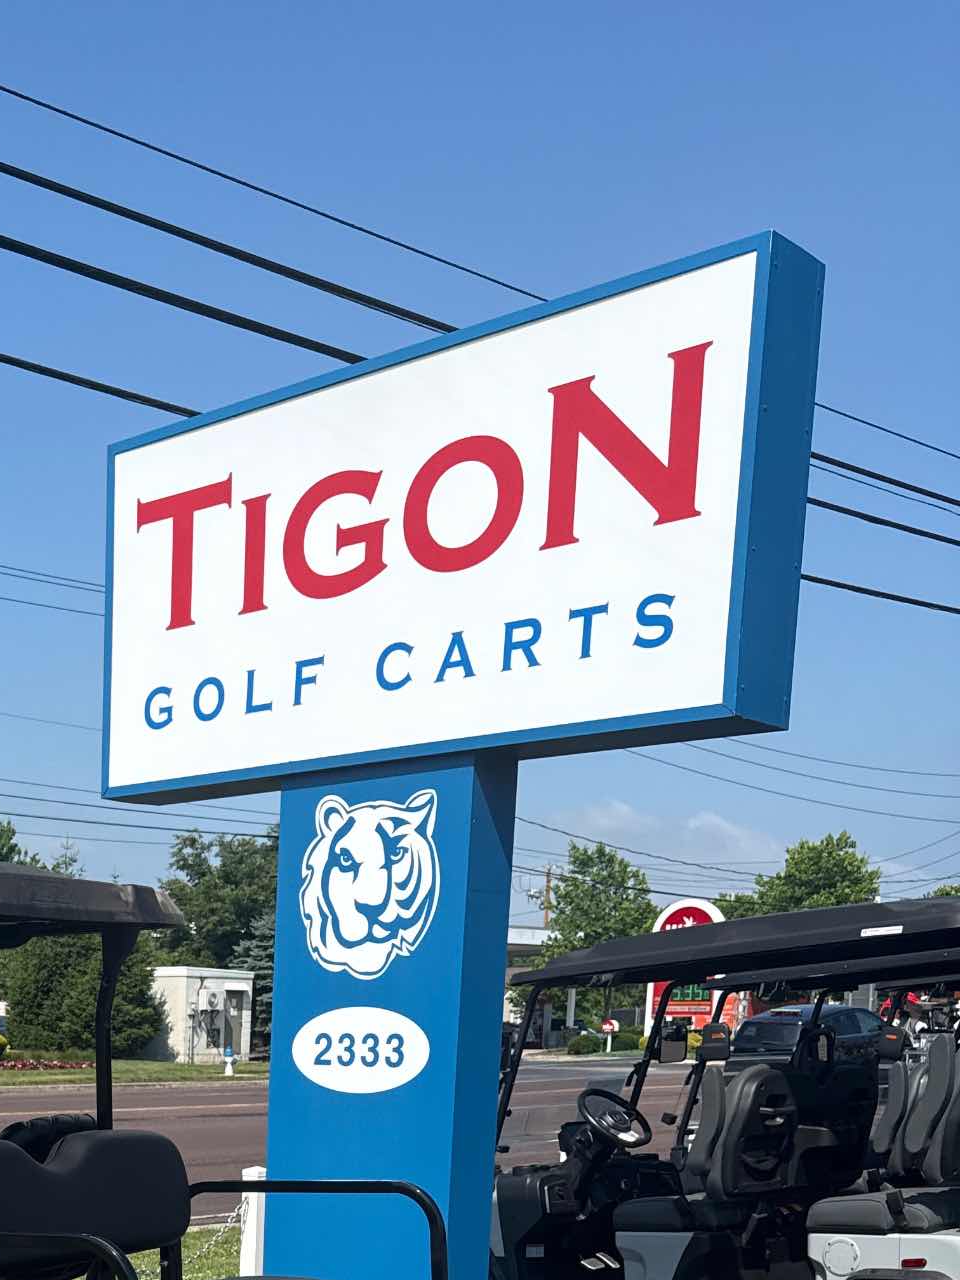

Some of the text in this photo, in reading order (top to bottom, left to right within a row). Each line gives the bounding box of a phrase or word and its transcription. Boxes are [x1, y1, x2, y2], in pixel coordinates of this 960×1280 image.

[137, 341, 714, 631] TIGON
[144, 593, 675, 730] GOLF CARTS
[313, 1032, 405, 1068] 2333
